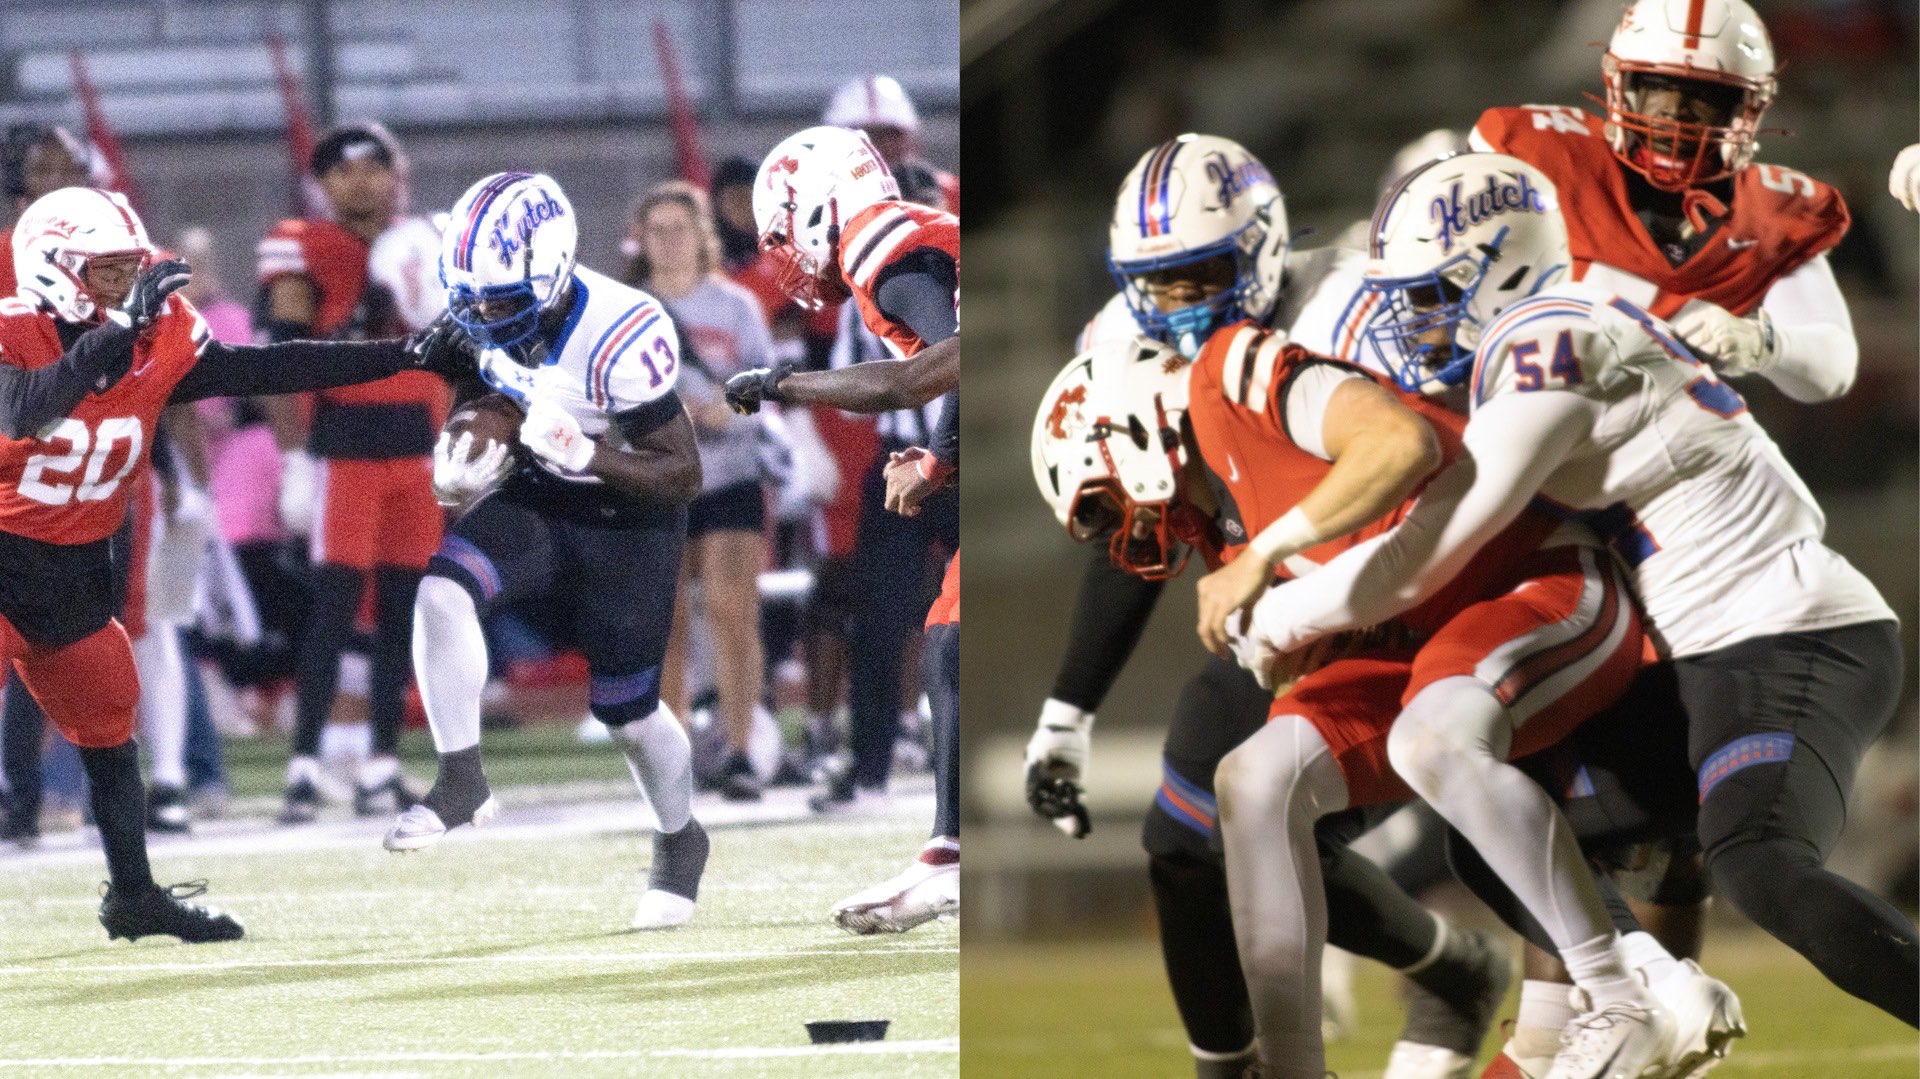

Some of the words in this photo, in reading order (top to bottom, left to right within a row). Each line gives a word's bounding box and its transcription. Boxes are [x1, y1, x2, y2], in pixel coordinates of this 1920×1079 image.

[489, 187, 564, 269] Hutch
[1429, 172, 1546, 255] Hutch
[639, 335, 676, 389] 13
[1507, 327, 1584, 393] 54
[17, 415, 143, 506] 20
